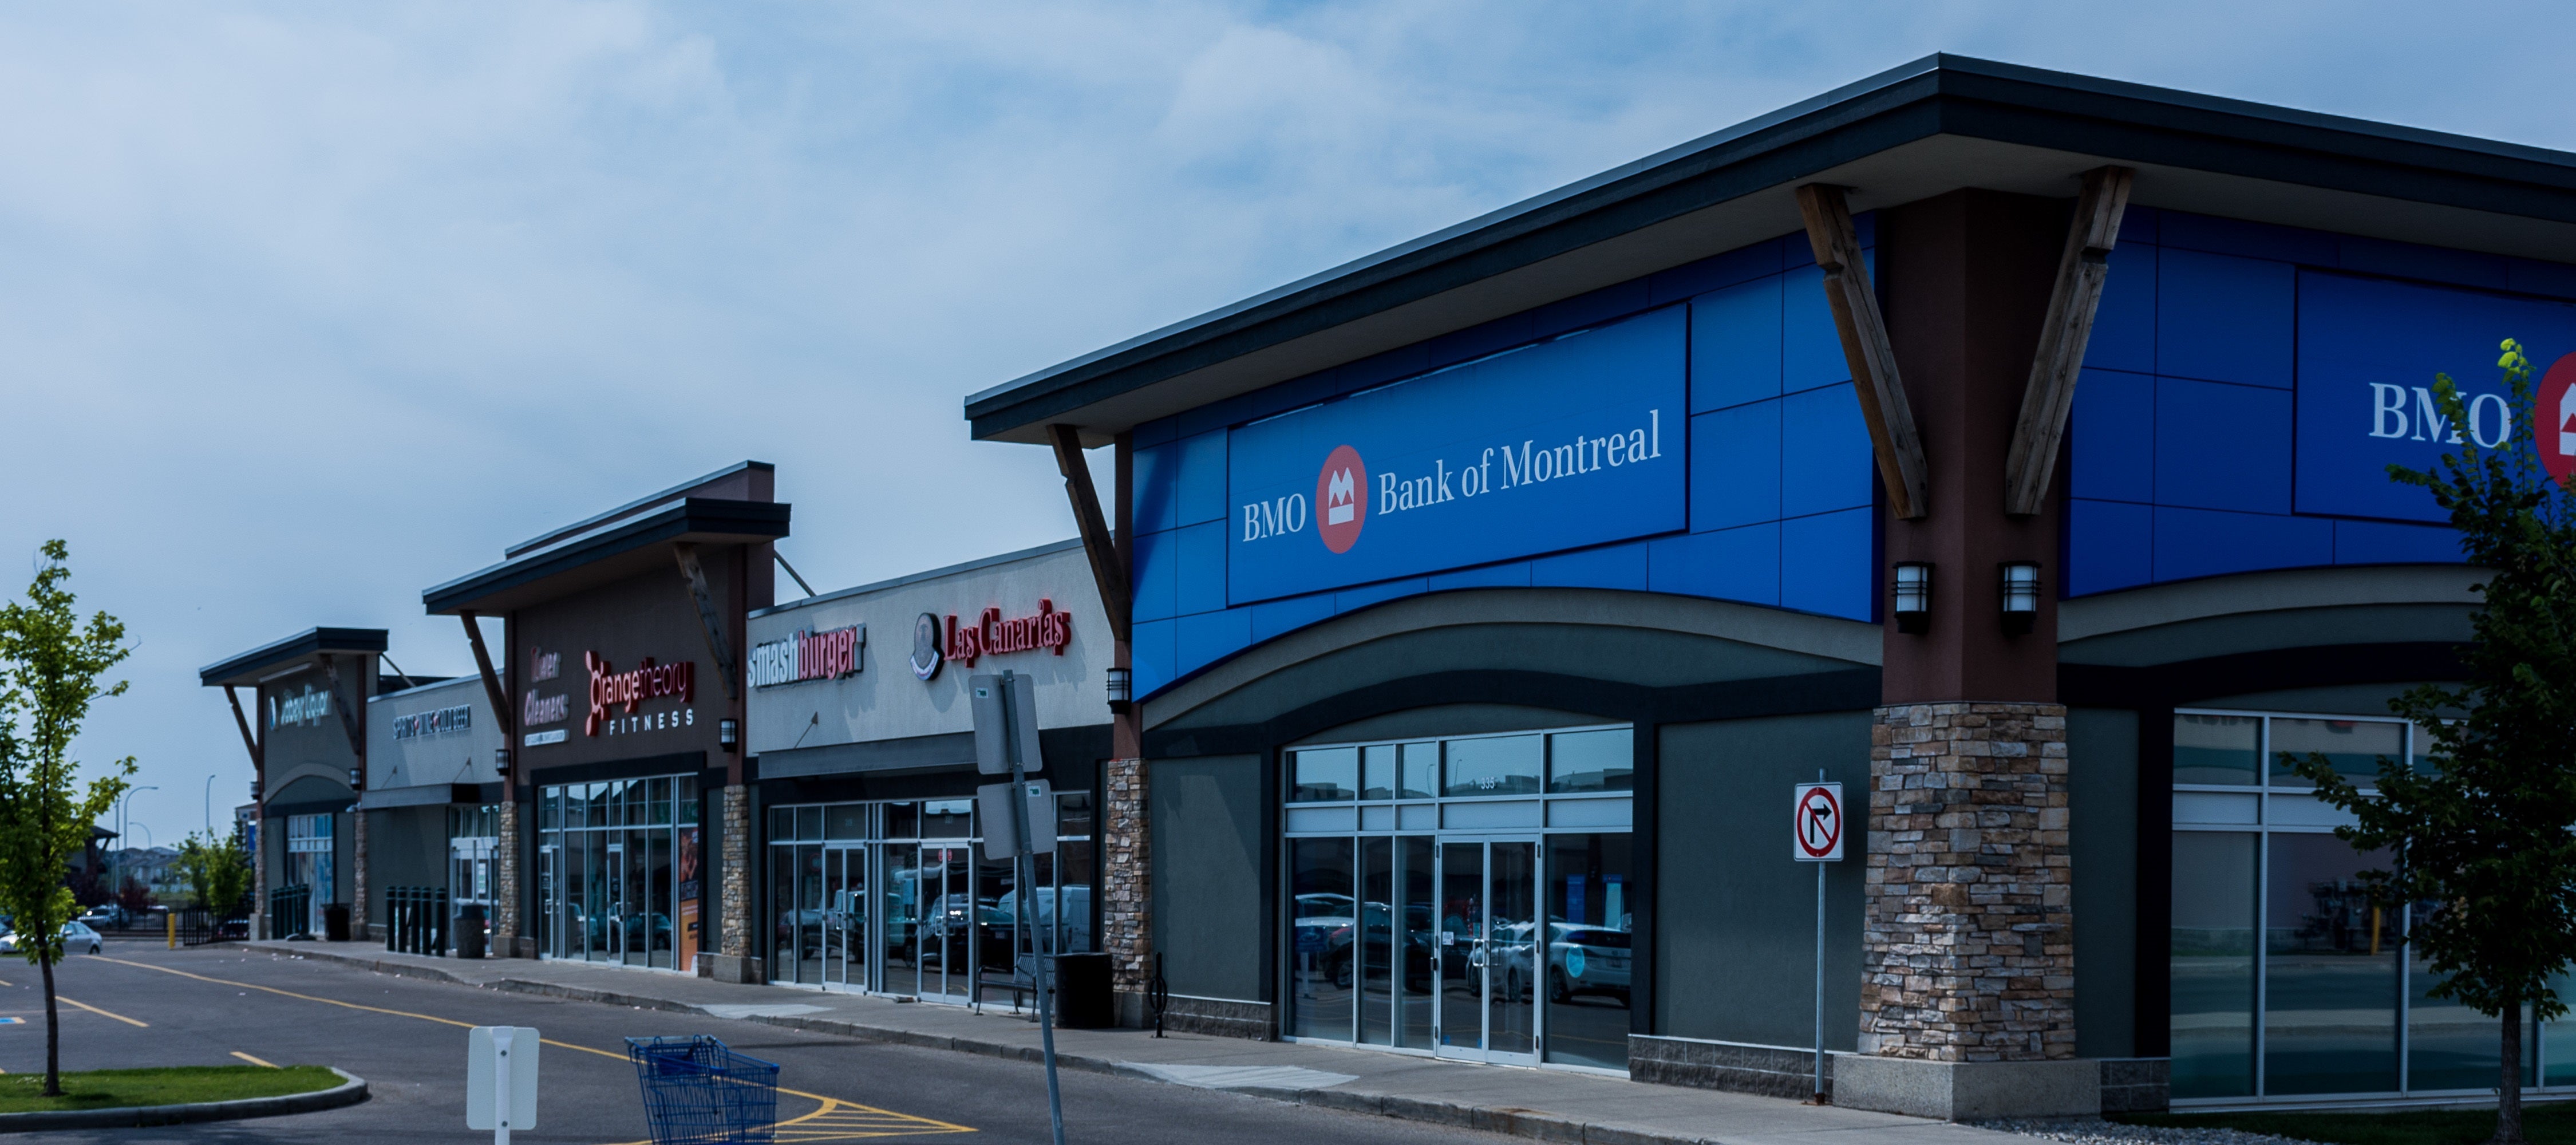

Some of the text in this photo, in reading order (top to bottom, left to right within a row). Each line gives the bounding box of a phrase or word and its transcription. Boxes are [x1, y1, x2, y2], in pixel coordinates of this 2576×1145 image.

[2369, 382, 2512, 448] BMO
[1243, 409, 1661, 542] BMO Bank of Montreal
[747, 626, 857, 688] smashburger
[943, 615, 977, 668] Las
[609, 708, 693, 736] FITNESS
[1480, 777, 1495, 790] 335
